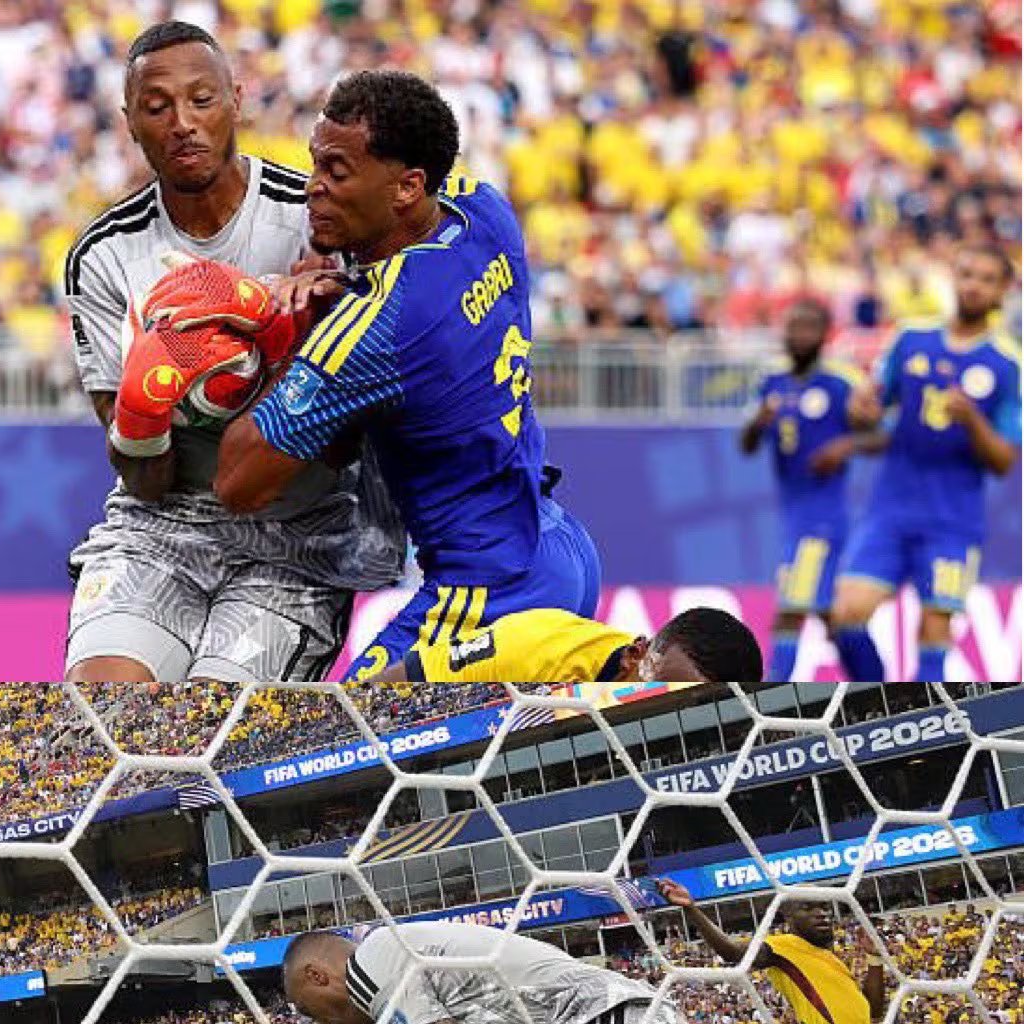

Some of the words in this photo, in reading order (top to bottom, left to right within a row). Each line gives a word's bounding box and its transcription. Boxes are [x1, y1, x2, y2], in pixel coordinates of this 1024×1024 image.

[264, 767, 298, 785] FIFA
[299, 750, 355, 776] WORLD
[390, 727, 451, 753] 2026
[655, 771, 710, 793] FIFA
[869, 710, 972, 751] 2026
[715, 865, 761, 888] FIFA
[893, 826, 977, 857] 2026
